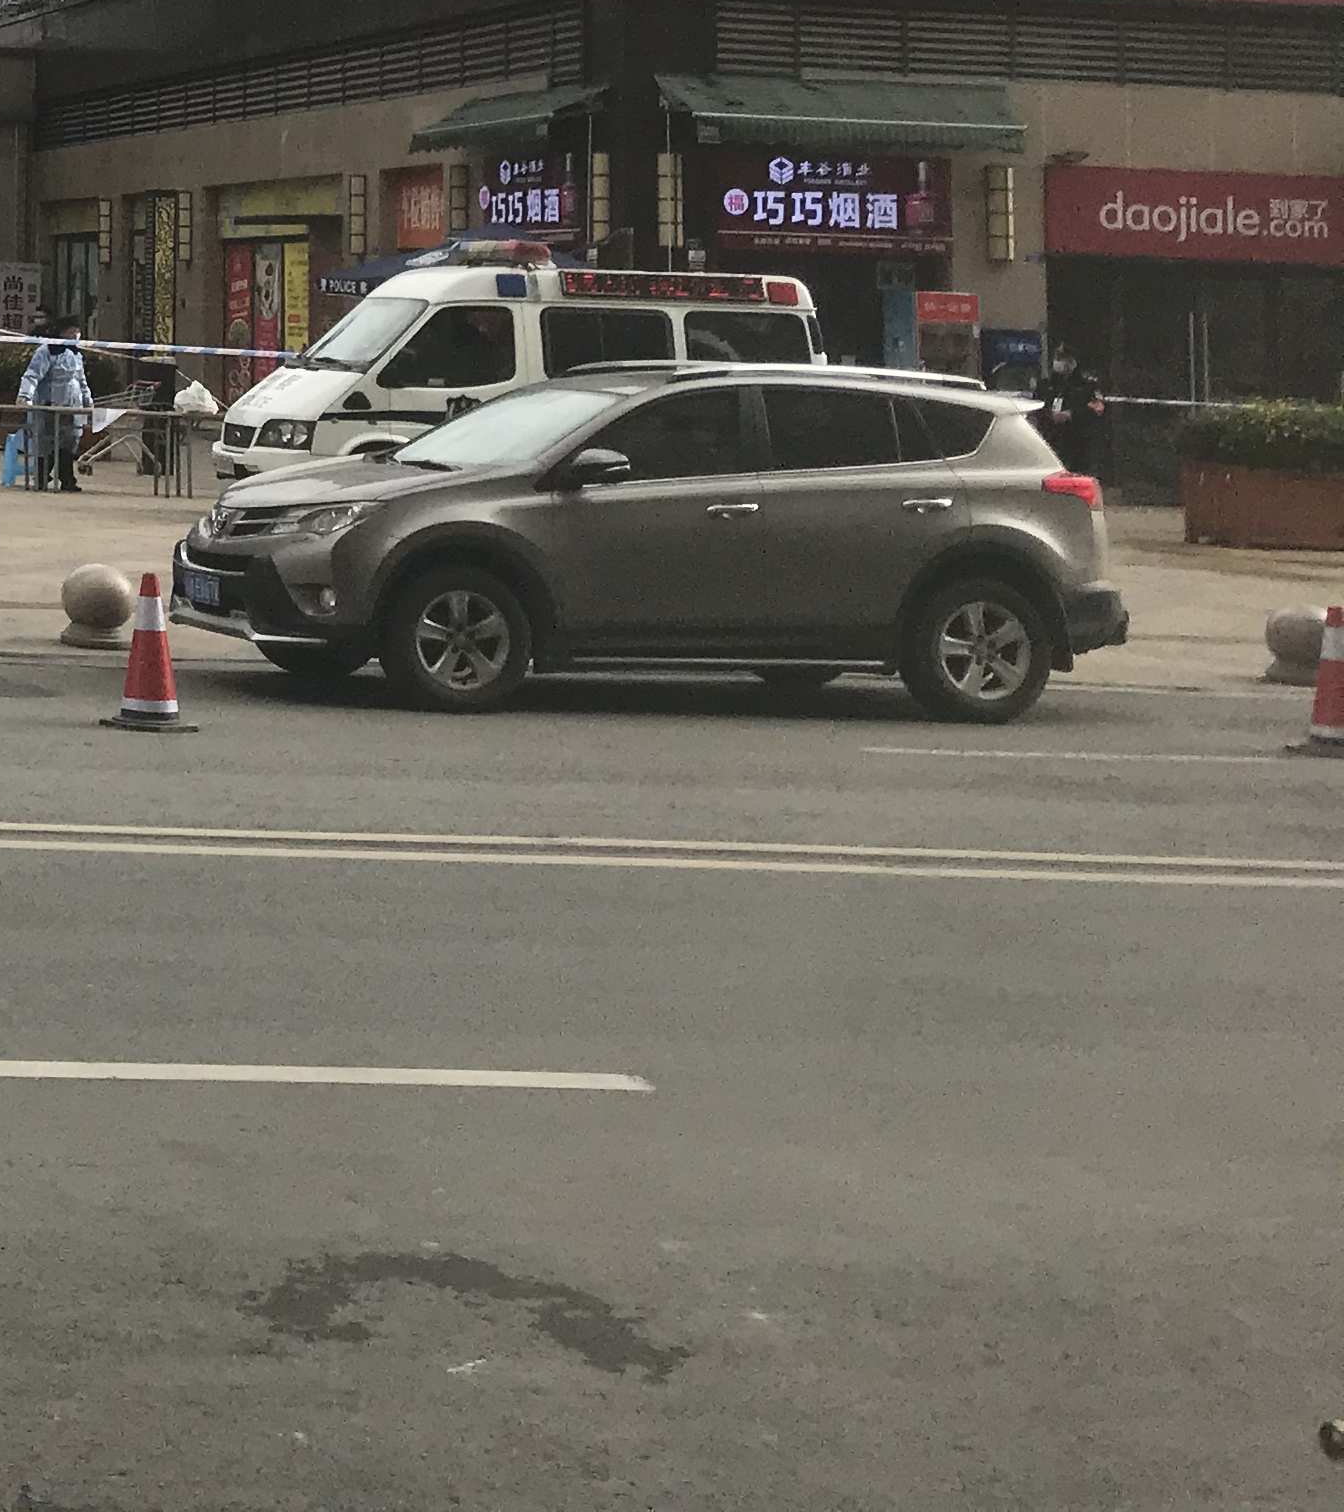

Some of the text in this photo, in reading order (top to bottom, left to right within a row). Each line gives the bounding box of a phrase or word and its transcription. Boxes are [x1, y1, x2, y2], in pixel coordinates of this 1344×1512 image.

[753, 190, 899, 230] 巧巧烟酒
[329, 279, 357, 294] POLICE
